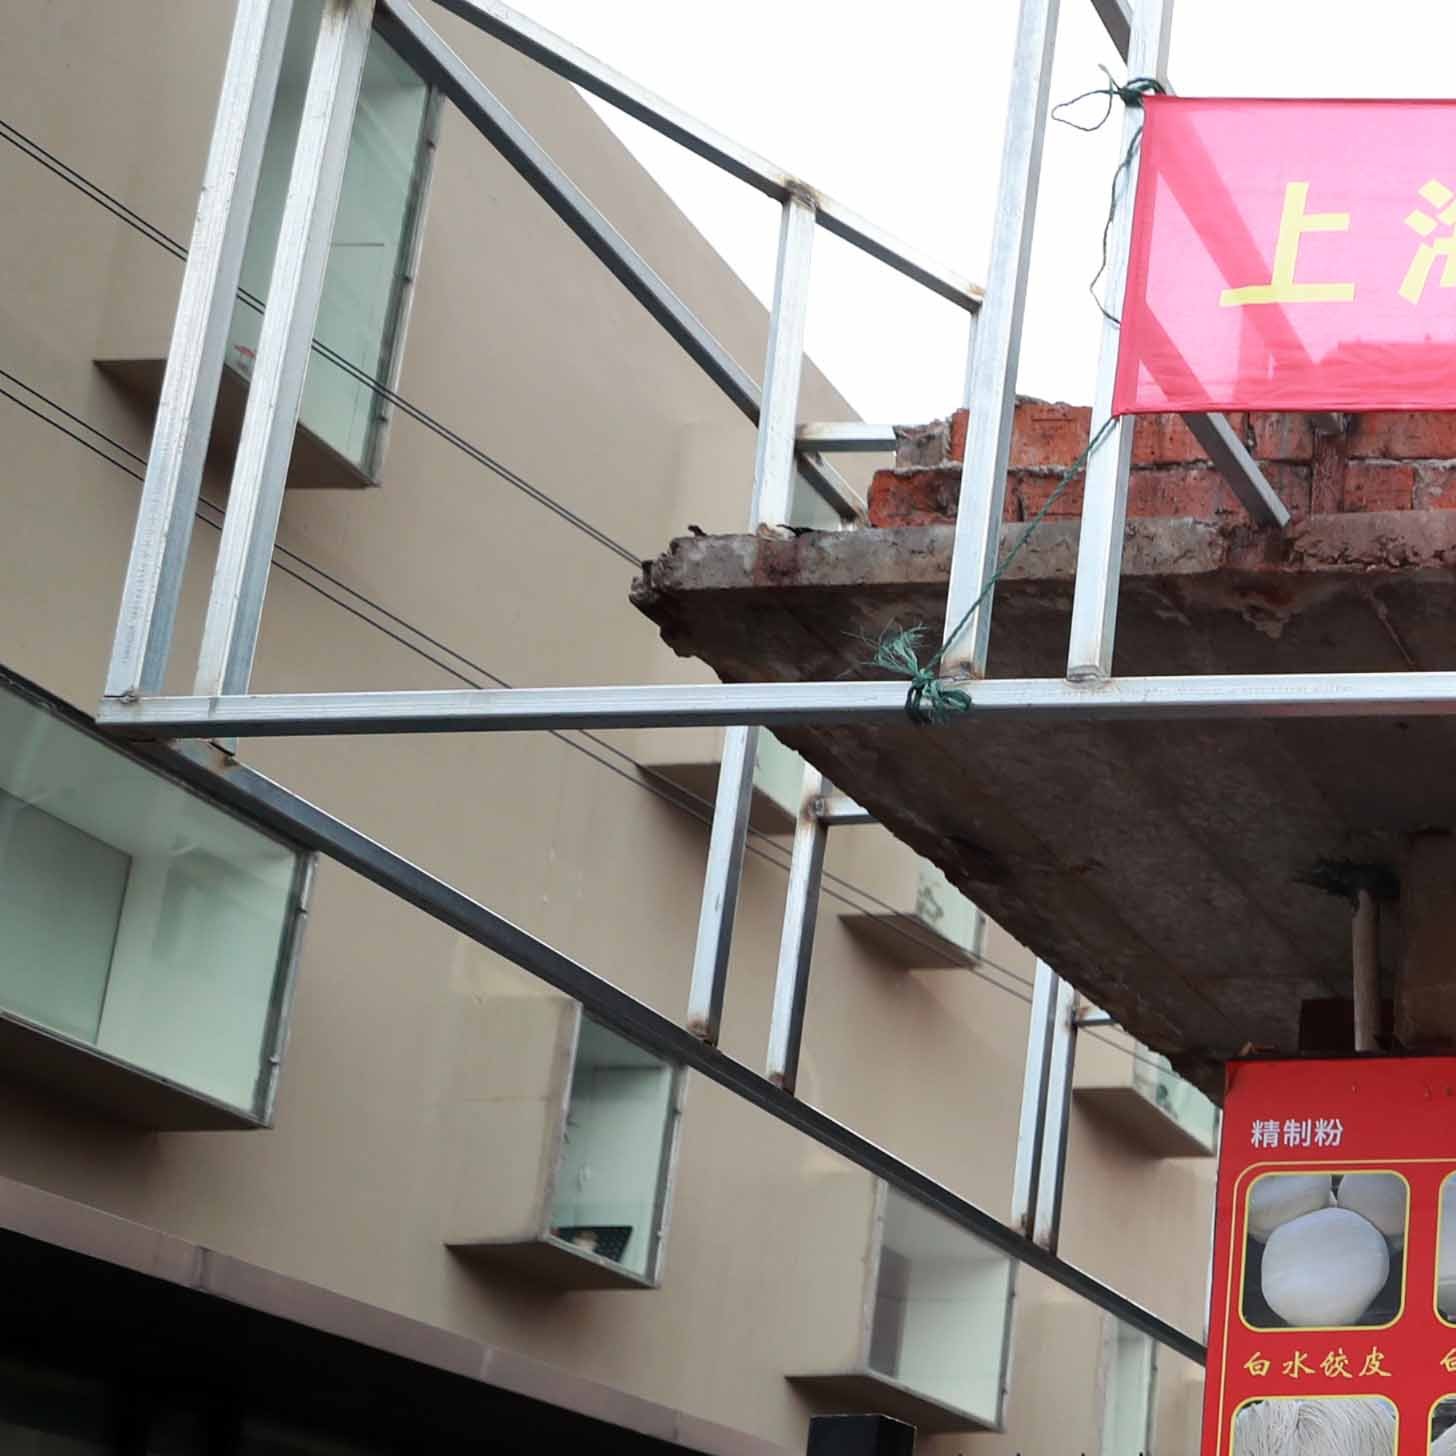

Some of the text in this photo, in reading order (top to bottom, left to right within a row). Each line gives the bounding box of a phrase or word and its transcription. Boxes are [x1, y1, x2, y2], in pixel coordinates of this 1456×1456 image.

[1251, 1119, 1343, 1148] 精制粉
[1244, 1347, 1391, 1378] 白水饺皮
